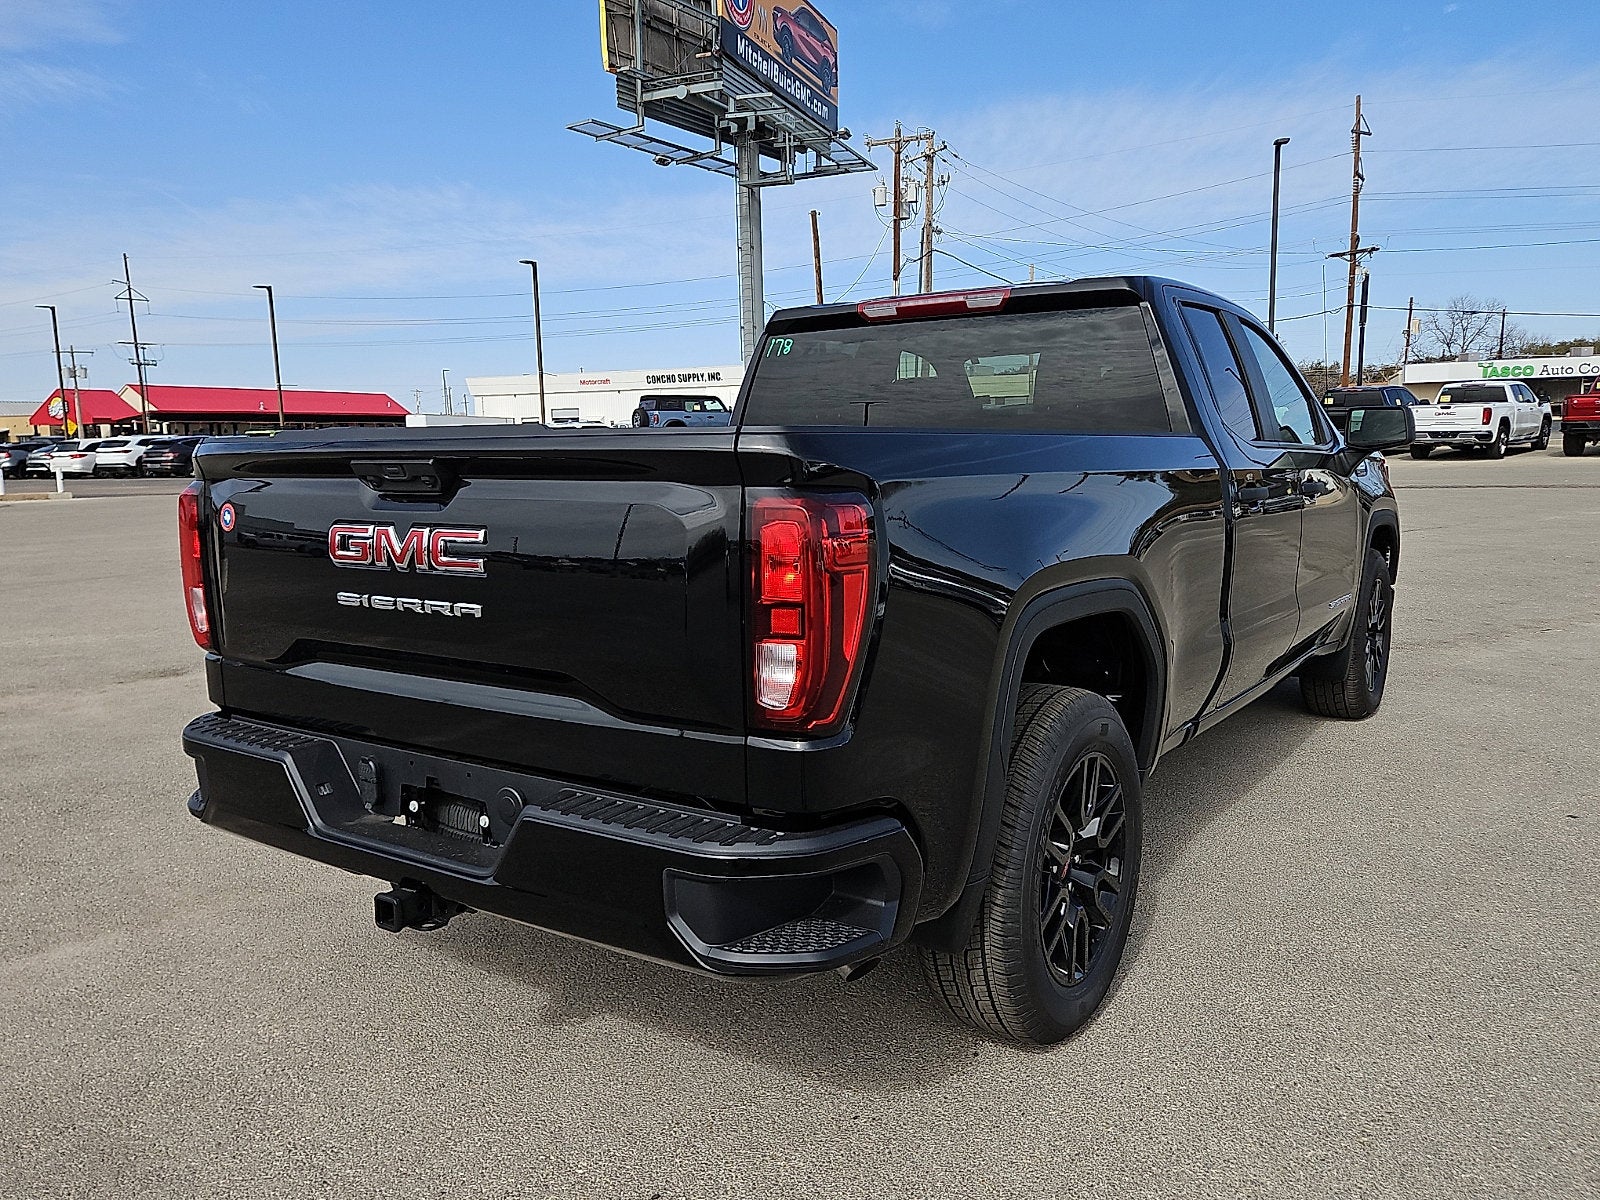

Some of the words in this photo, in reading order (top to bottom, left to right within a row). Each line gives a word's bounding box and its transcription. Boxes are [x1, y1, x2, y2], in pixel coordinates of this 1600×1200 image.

[737, 34, 829, 121] MitchellBuickGMC.com
[766, 338, 794, 358] 178
[646, 374, 677, 385] CONCHO
[678, 372, 707, 383] SUPPLY,
[707, 371, 724, 382] INC.
[1477, 361, 1535, 379] TASCO
[1539, 364, 1574, 376] Auto
[579, 378, 611, 386] Motorcraft
[328, 522, 488, 577] GMC
[336, 591, 484, 619] SIERRA
